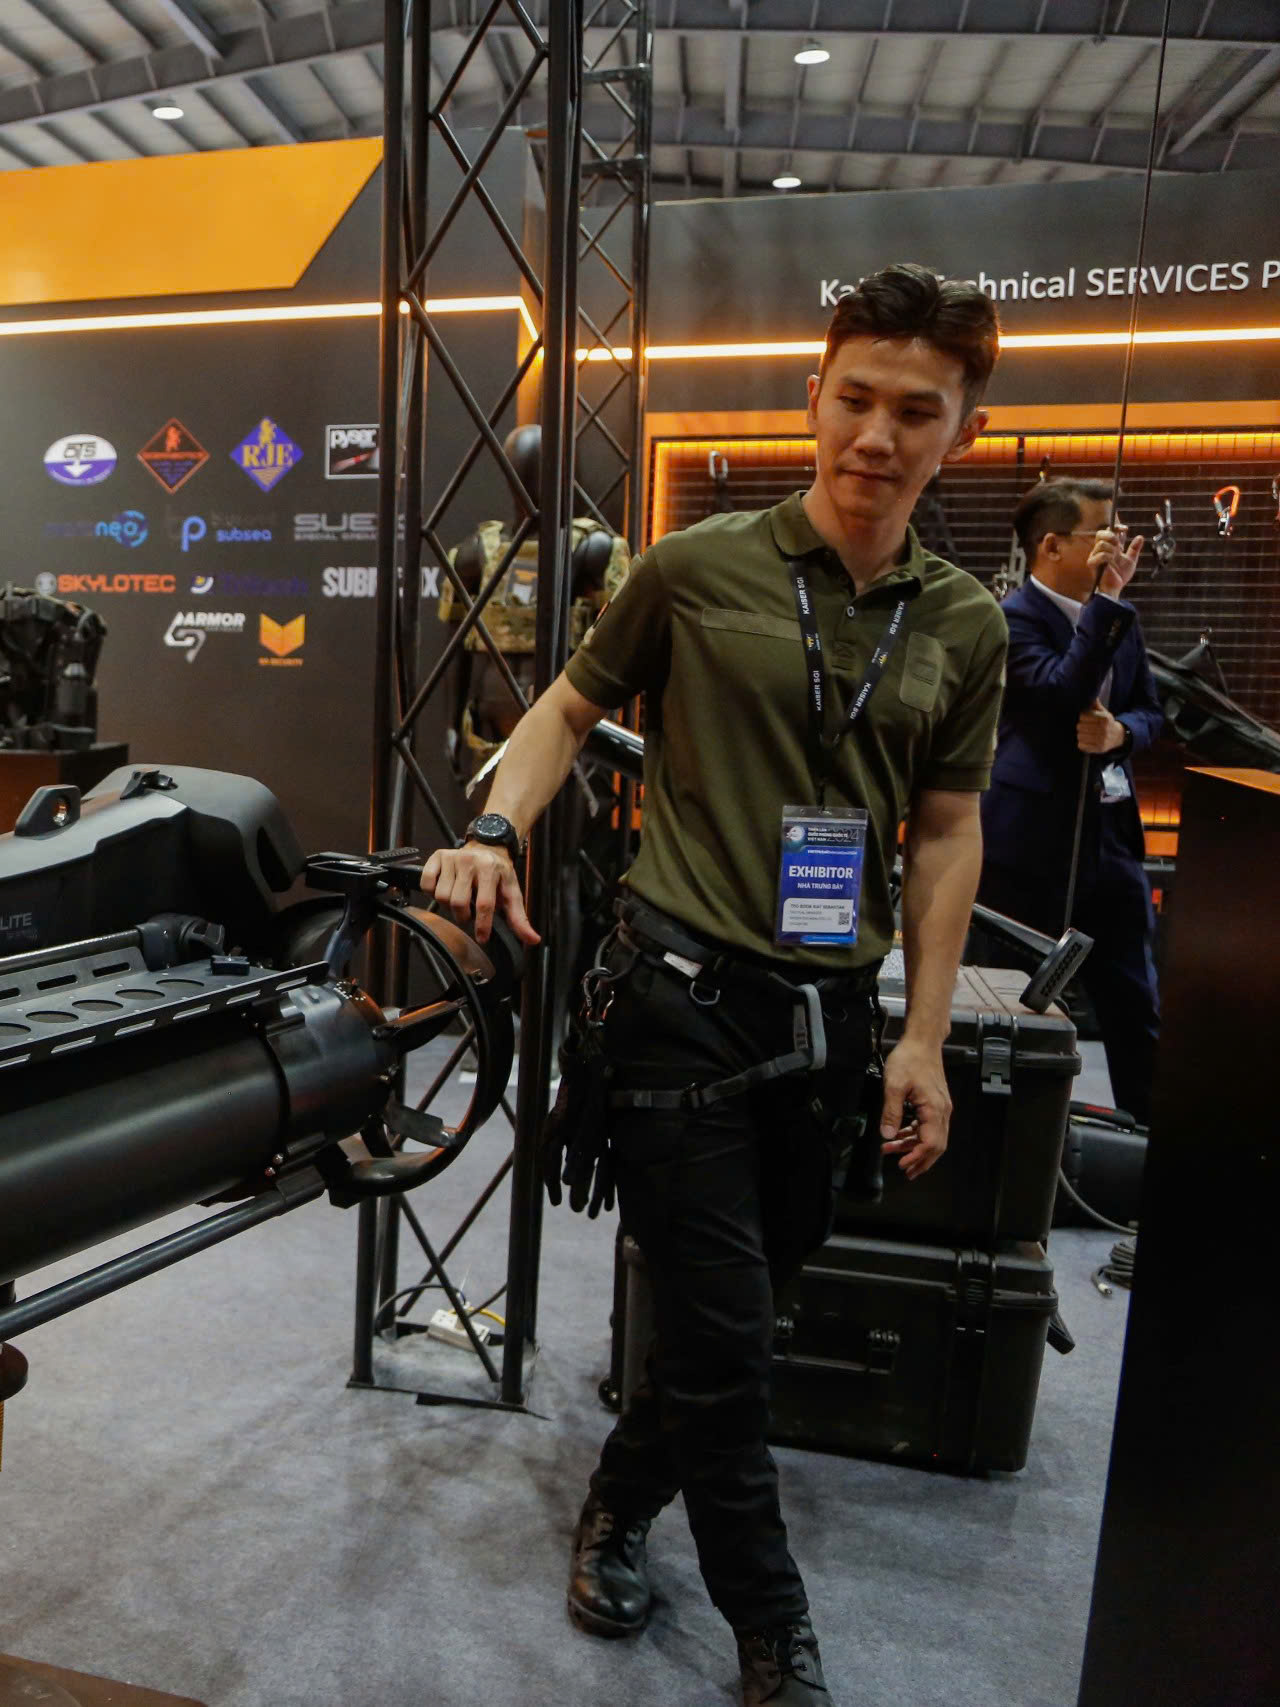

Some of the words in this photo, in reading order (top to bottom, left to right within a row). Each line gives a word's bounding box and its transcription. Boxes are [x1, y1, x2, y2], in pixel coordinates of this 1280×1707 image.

[1085, 262, 1249, 297] SERVICES
[242, 444, 294, 467] RJE
[217, 528, 272, 542] subsea
[58, 575, 176, 593] SKYLOTEC
[797, 577, 806, 589] SGI
[799, 589, 810, 615] KAISER
[893, 601, 905, 625] KAISER
[889, 623, 898, 635] SGI
[857, 682, 872, 709] KAISER
[849, 706, 859, 720] SGI
[788, 865, 853, 879] EXHIBITOR
